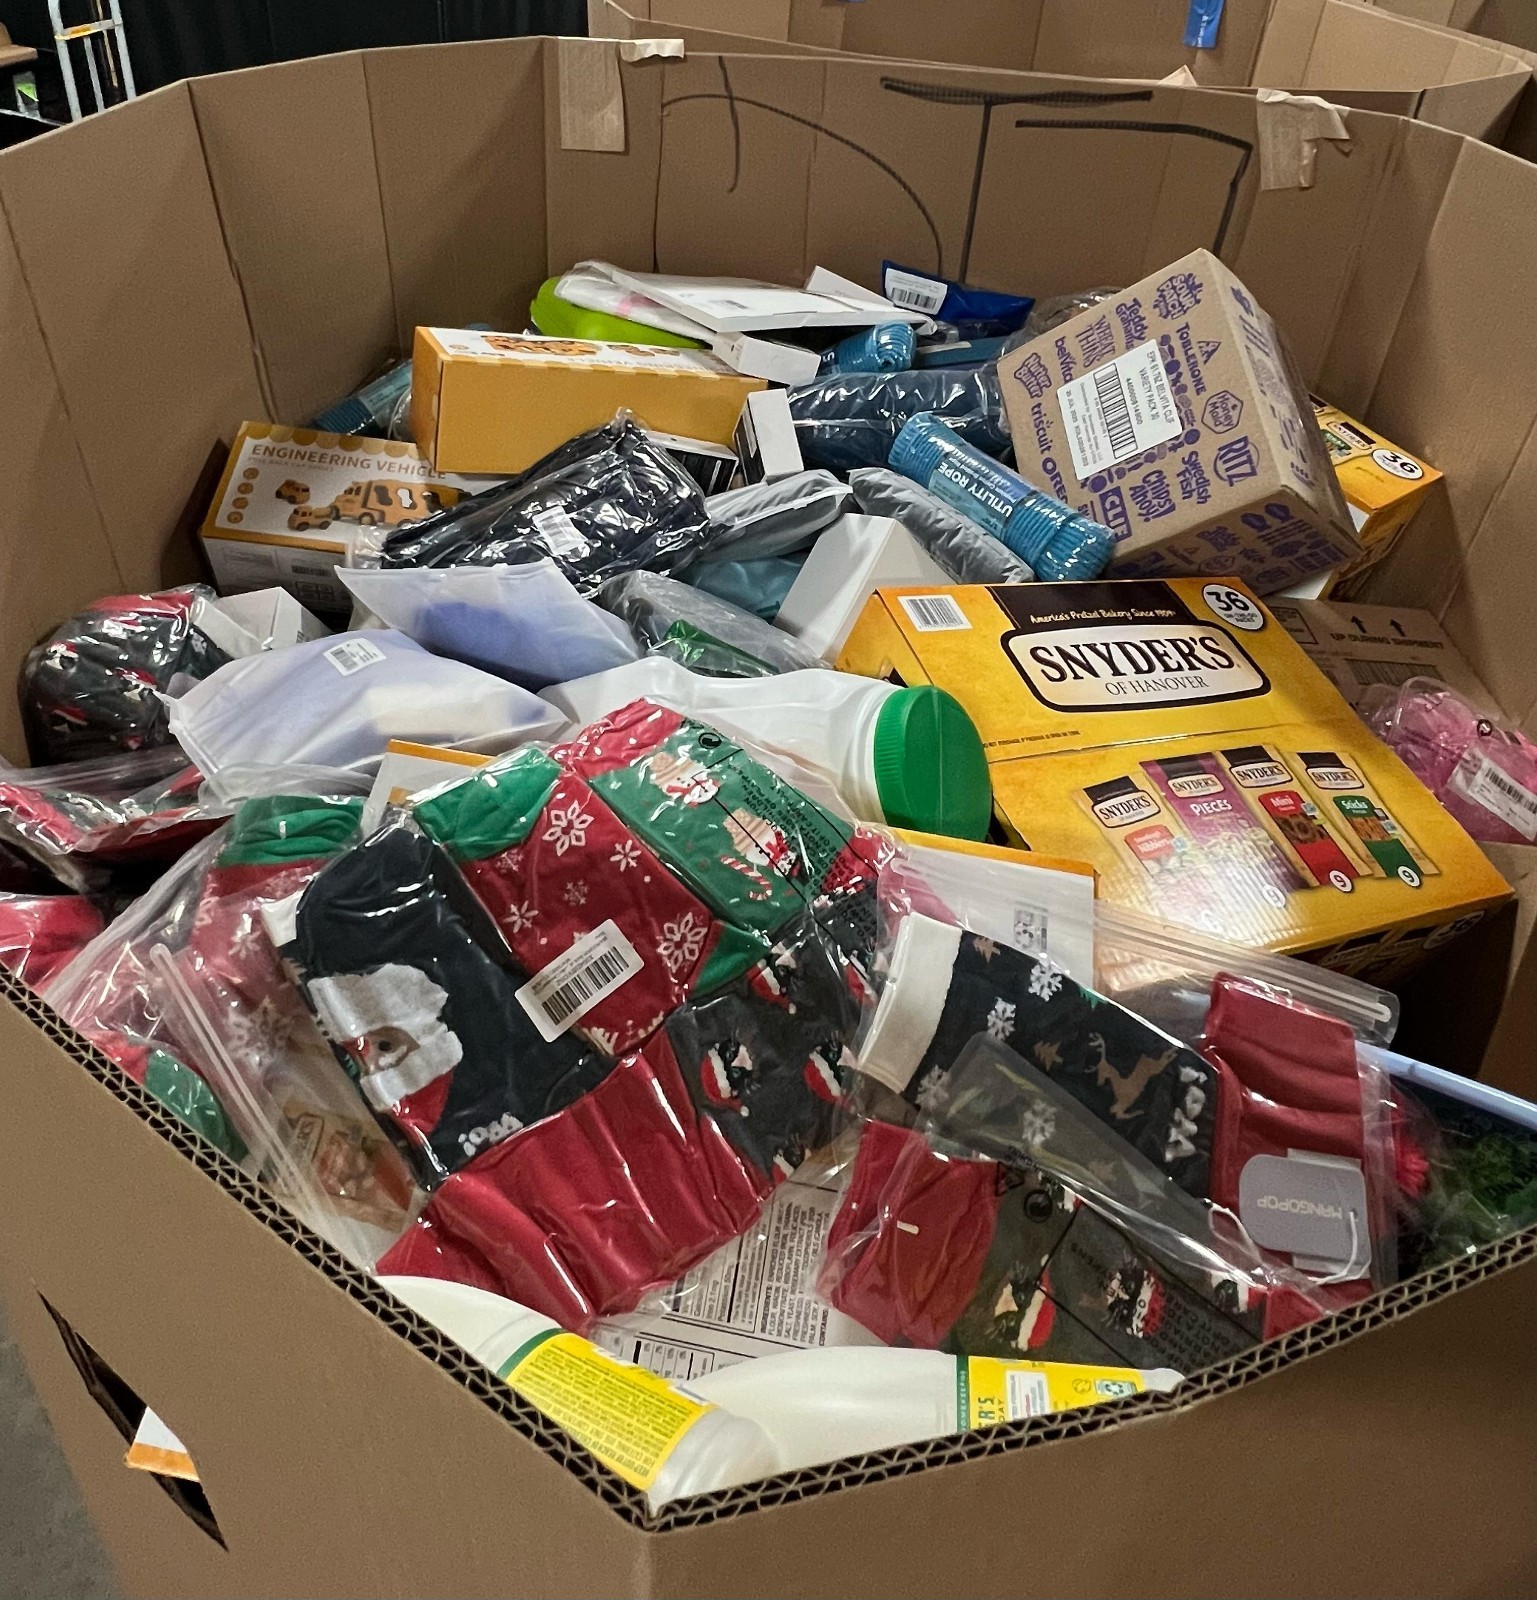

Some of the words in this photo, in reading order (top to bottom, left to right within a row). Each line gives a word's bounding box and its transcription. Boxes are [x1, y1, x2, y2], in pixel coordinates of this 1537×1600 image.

[1172, 274, 1197, 311] SOUR
[1128, 298, 1148, 341] Teddy
[1075, 324, 1101, 368] THINS
[1094, 315, 1116, 358] WHEAT
[1026, 352, 1052, 389] Nutter
[1176, 322, 1207, 396] TOBLERONE
[1015, 366, 1043, 399] Butter
[1206, 401, 1224, 428] Maid
[1216, 393, 1235, 428] Honey
[1031, 403, 1053, 454] triscuit
[252, 444, 371, 469] ENGINEERING
[376, 459, 447, 479] VEHICLE
[936, 459, 970, 489] ROPE
[1217, 435, 1258, 487] RITZ
[1382, 452, 1417, 474] 36
[1142, 469, 1174, 513] Chips
[1176, 466, 1194, 501] Fish
[1182, 451, 1212, 505] Swedish
[967, 479, 1014, 518] UTILITY
[1030, 612, 1070, 624] America's
[1070, 610, 1100, 619] Pretzel
[1100, 609, 1133, 620] Bakery
[1131, 608, 1155, 617] Since
[1206, 591, 1249, 611] 36
[1029, 636, 1235, 682] SNYDER'S
[1105, 681, 1128, 696] OF
[1129, 675, 1209, 694] HANOVER
[1172, 776, 1219, 791] SNYDER'S
[1236, 766, 1284, 781] SNYDER'S
[1313, 771, 1356, 782] SNYDER'S
[1098, 796, 1151, 820] SNYDER'S
[1190, 799, 1232, 816] PIECES
[1271, 796, 1294, 807] Mini
[1341, 799, 1368, 810] Sticks
[1334, 874, 1346, 887] 9
[1403, 870, 1414, 882] 9
